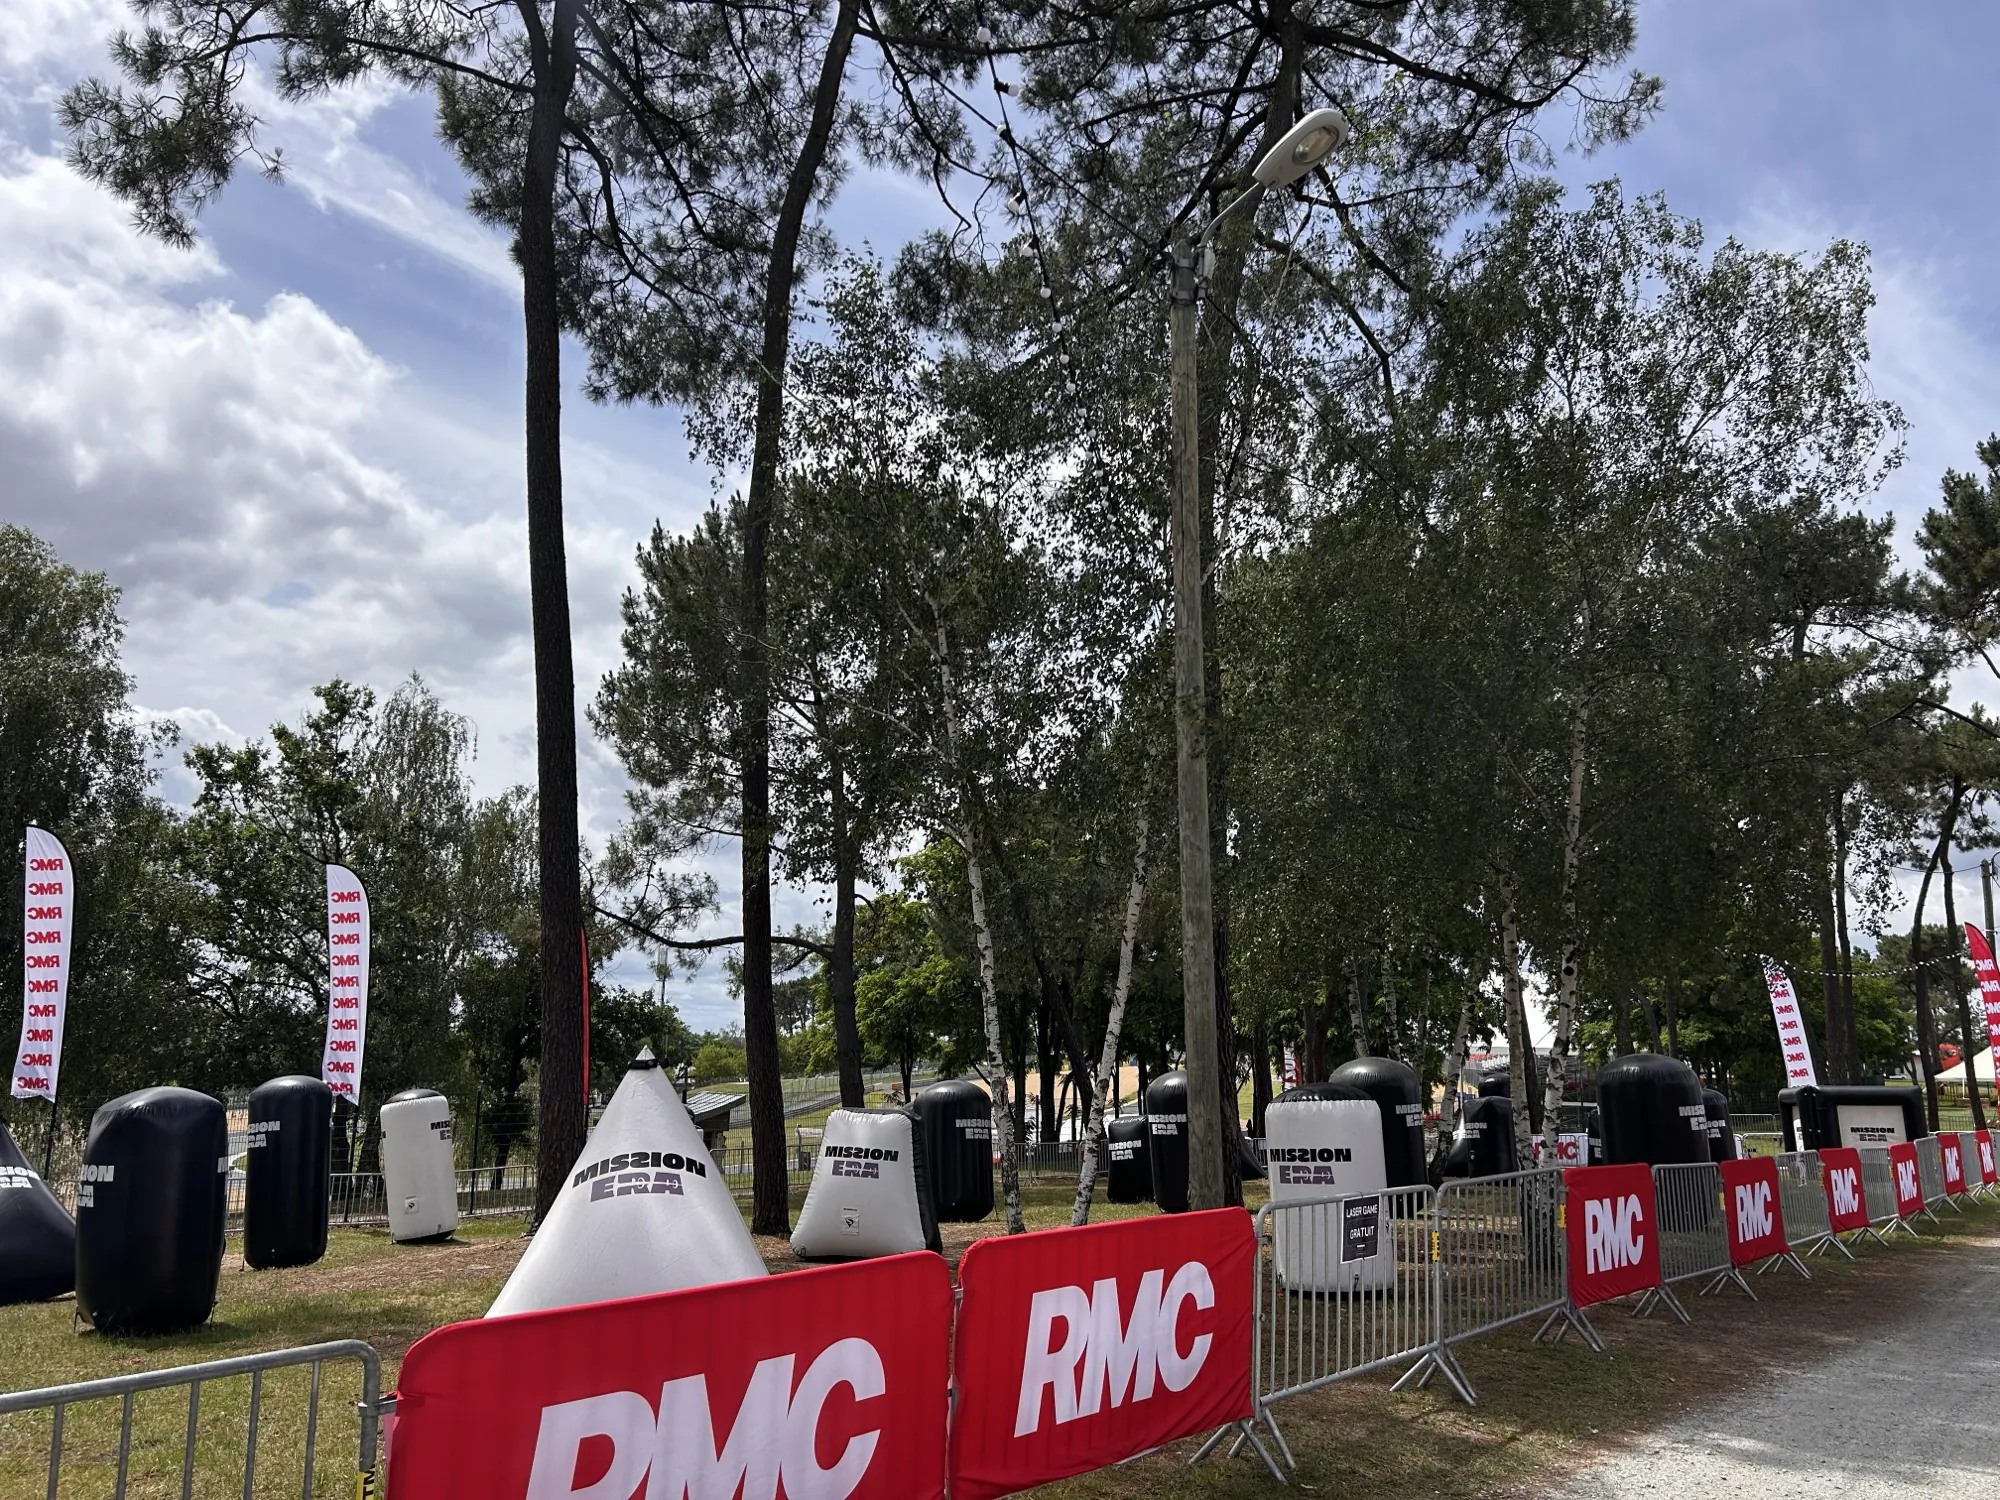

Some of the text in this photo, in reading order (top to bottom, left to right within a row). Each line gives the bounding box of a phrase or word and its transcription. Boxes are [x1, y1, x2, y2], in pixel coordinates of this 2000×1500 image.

[825, 1146, 899, 1162] MISSION
[1270, 1148, 1351, 1162] MISSION
[572, 1152, 706, 1188] MISSION
[832, 1160, 879, 1179] ERA
[1279, 1166, 1335, 1184] ERA
[1896, 1159, 1918, 1202] RMC
[590, 1172, 684, 1202] ERA
[1830, 1167, 1859, 1215] RMC
[1346, 1204, 1378, 1218] LASER GAME
[1735, 1180, 1773, 1243] RMC
[1349, 1226, 1375, 1239] GRATUIT
[1584, 1193, 1643, 1275] RMC
[1013, 1261, 1215, 1438] RMC
